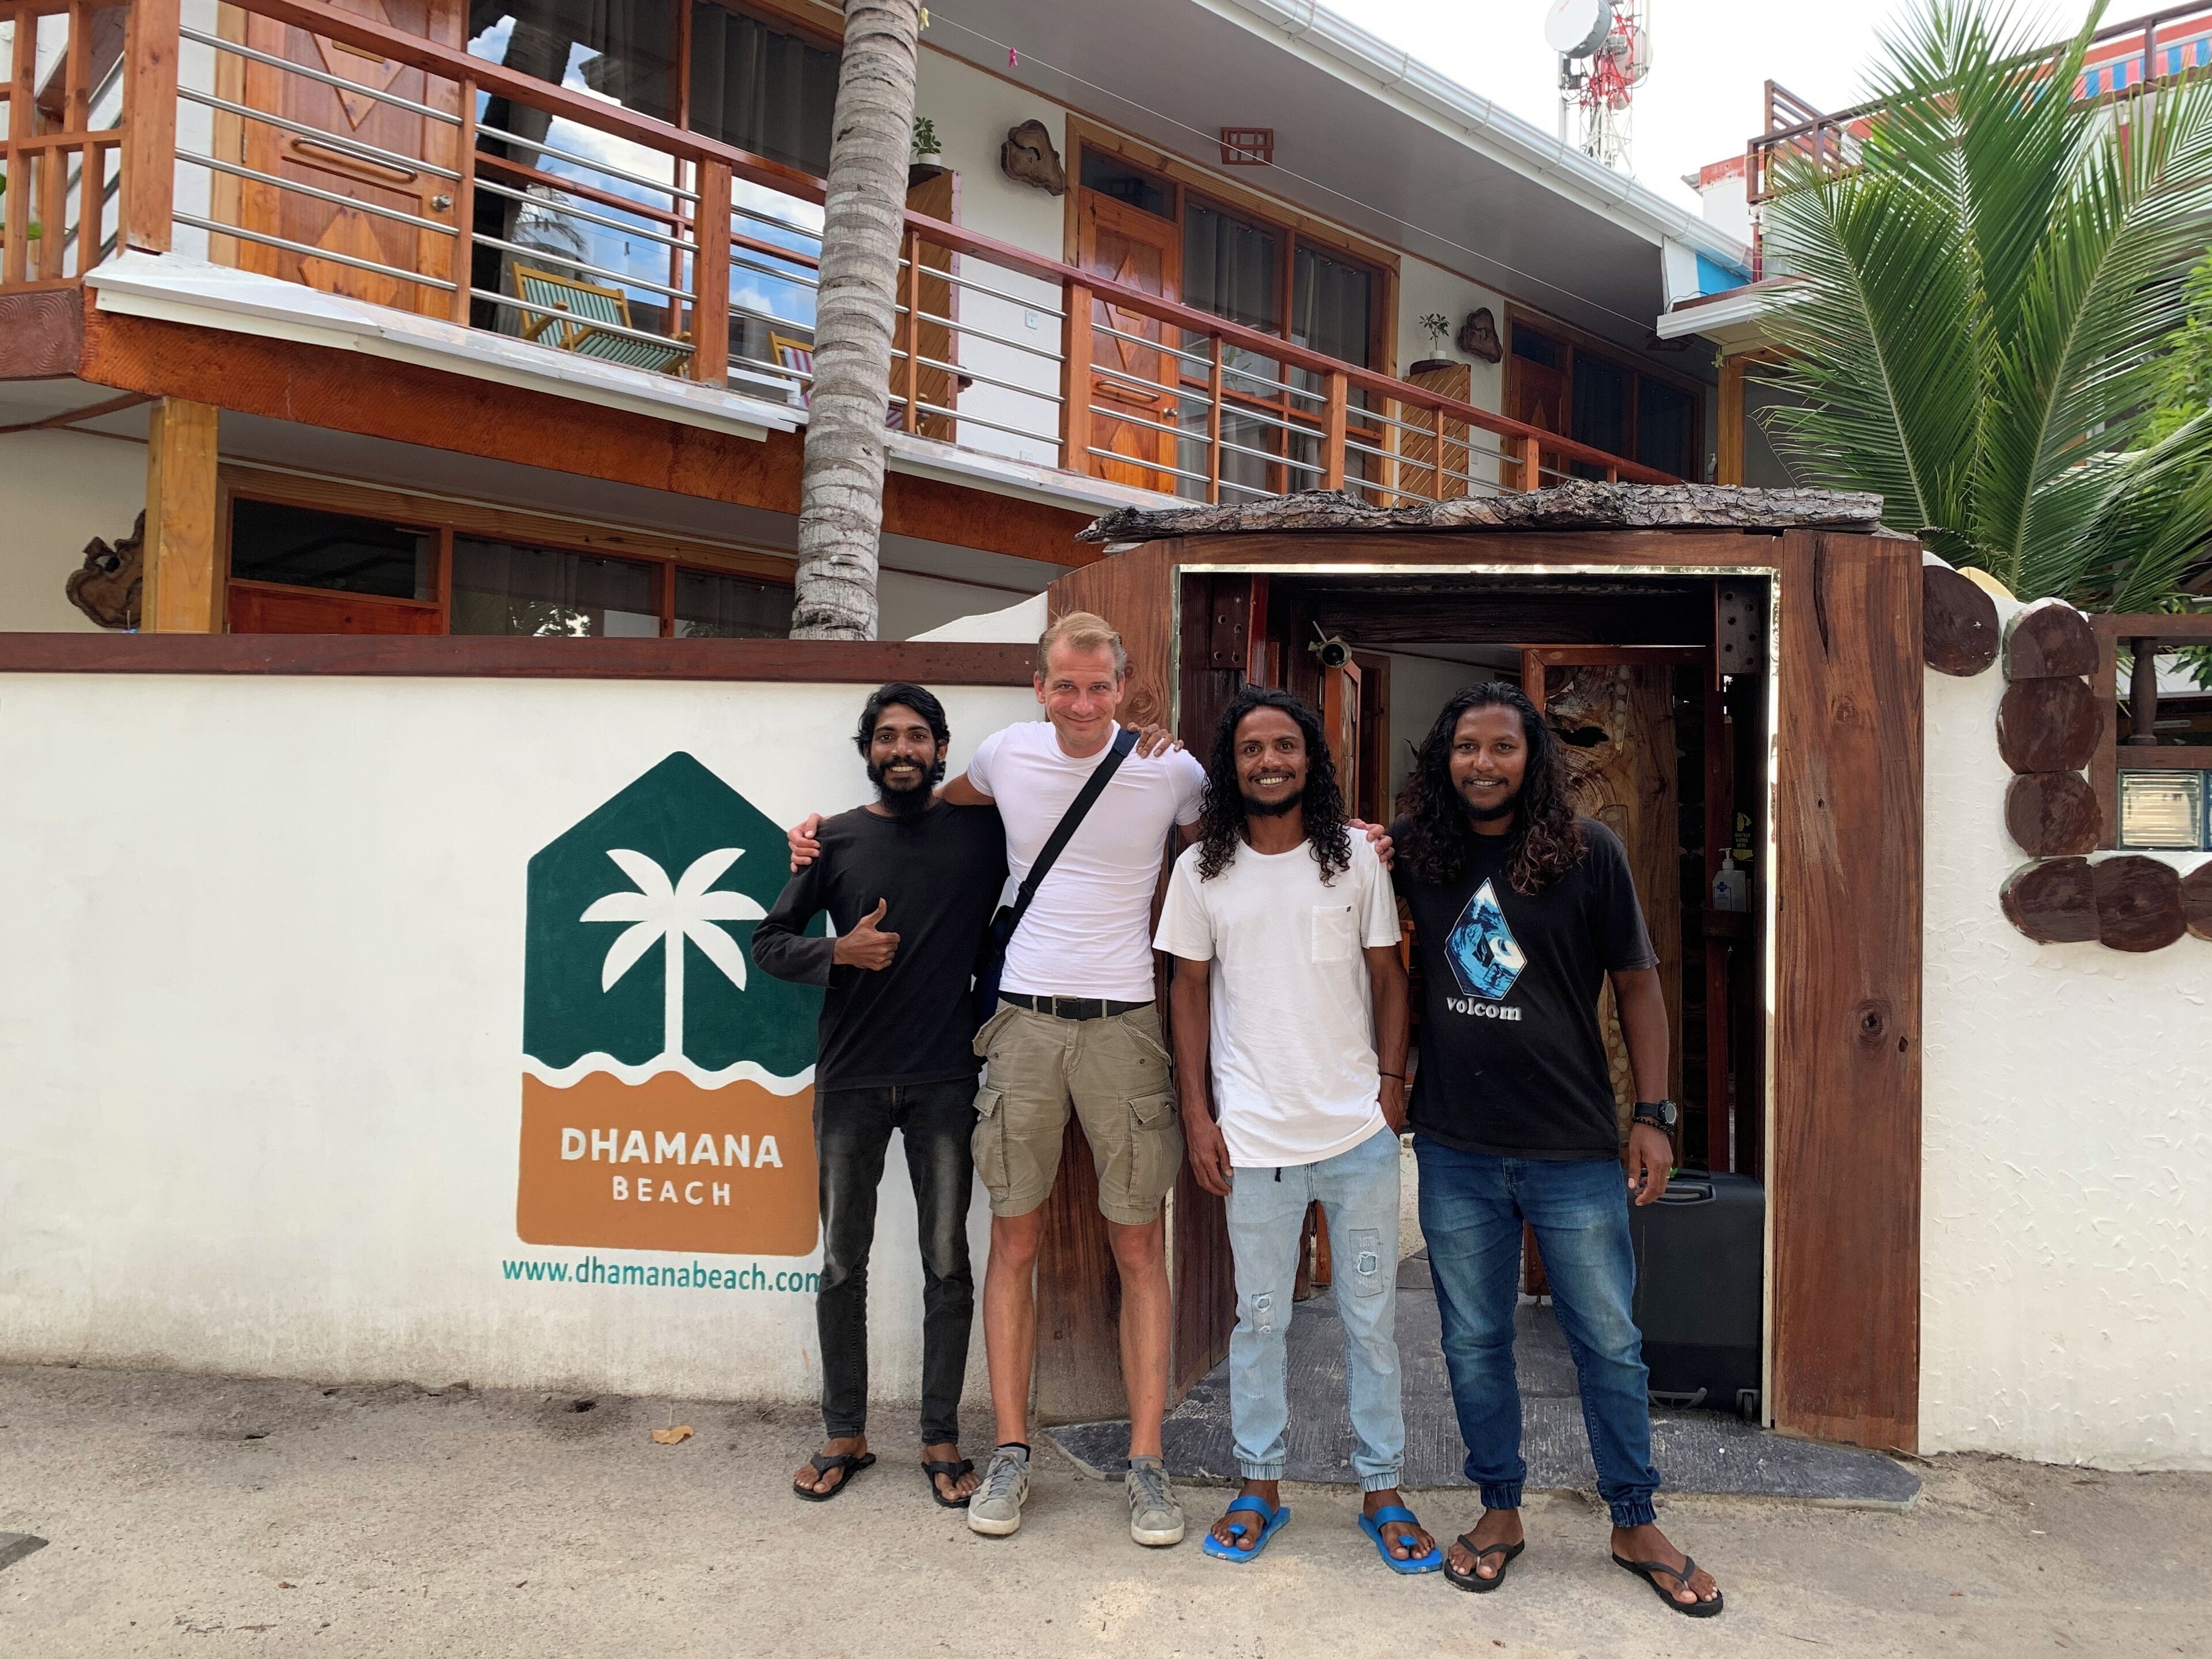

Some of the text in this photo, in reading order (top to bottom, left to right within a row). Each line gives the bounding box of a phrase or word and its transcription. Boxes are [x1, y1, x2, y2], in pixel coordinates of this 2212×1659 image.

[1446, 997, 1522, 1021] volcom
[561, 1128, 783, 1169] DHAMANA
[612, 1175, 730, 1206] BEACH
[502, 1256, 820, 1293] www.dhamanabeach.com
